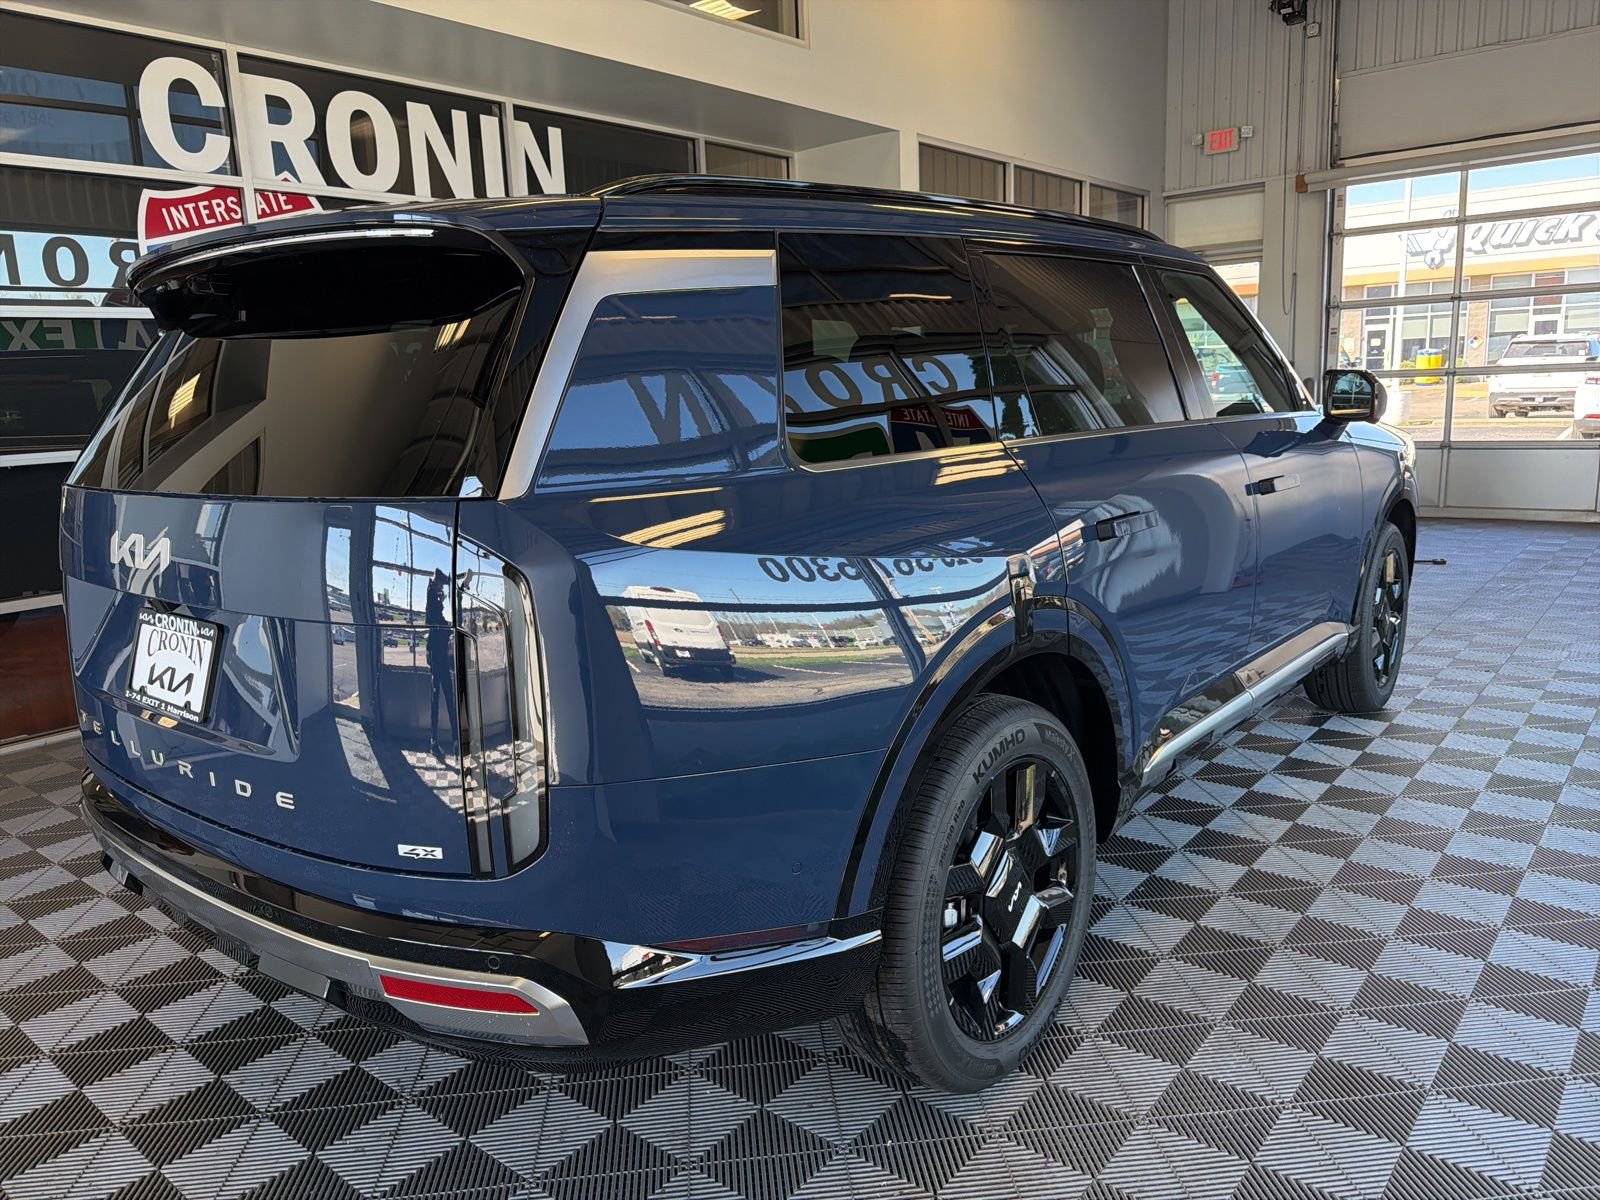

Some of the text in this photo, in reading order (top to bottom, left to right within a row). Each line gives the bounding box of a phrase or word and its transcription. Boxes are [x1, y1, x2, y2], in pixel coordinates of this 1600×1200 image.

[139, 56, 566, 198] CRONIN
[1209, 128, 1233, 152] EXIT
[161, 191, 293, 231] INTERSATE
[1464, 213, 1597, 254] QUICK
[111, 529, 171, 574] KIA
[155, 613, 198, 636] CRONIN
[148, 629, 206, 671] CRONIN
[148, 662, 194, 696] KIA
[125, 690, 140, 701] I-74
[142, 696, 160, 707] EXIT
[167, 704, 199, 722] Harrison
[80, 709, 295, 810] TELLURIDE
[972, 728, 1026, 785] KUMHO
